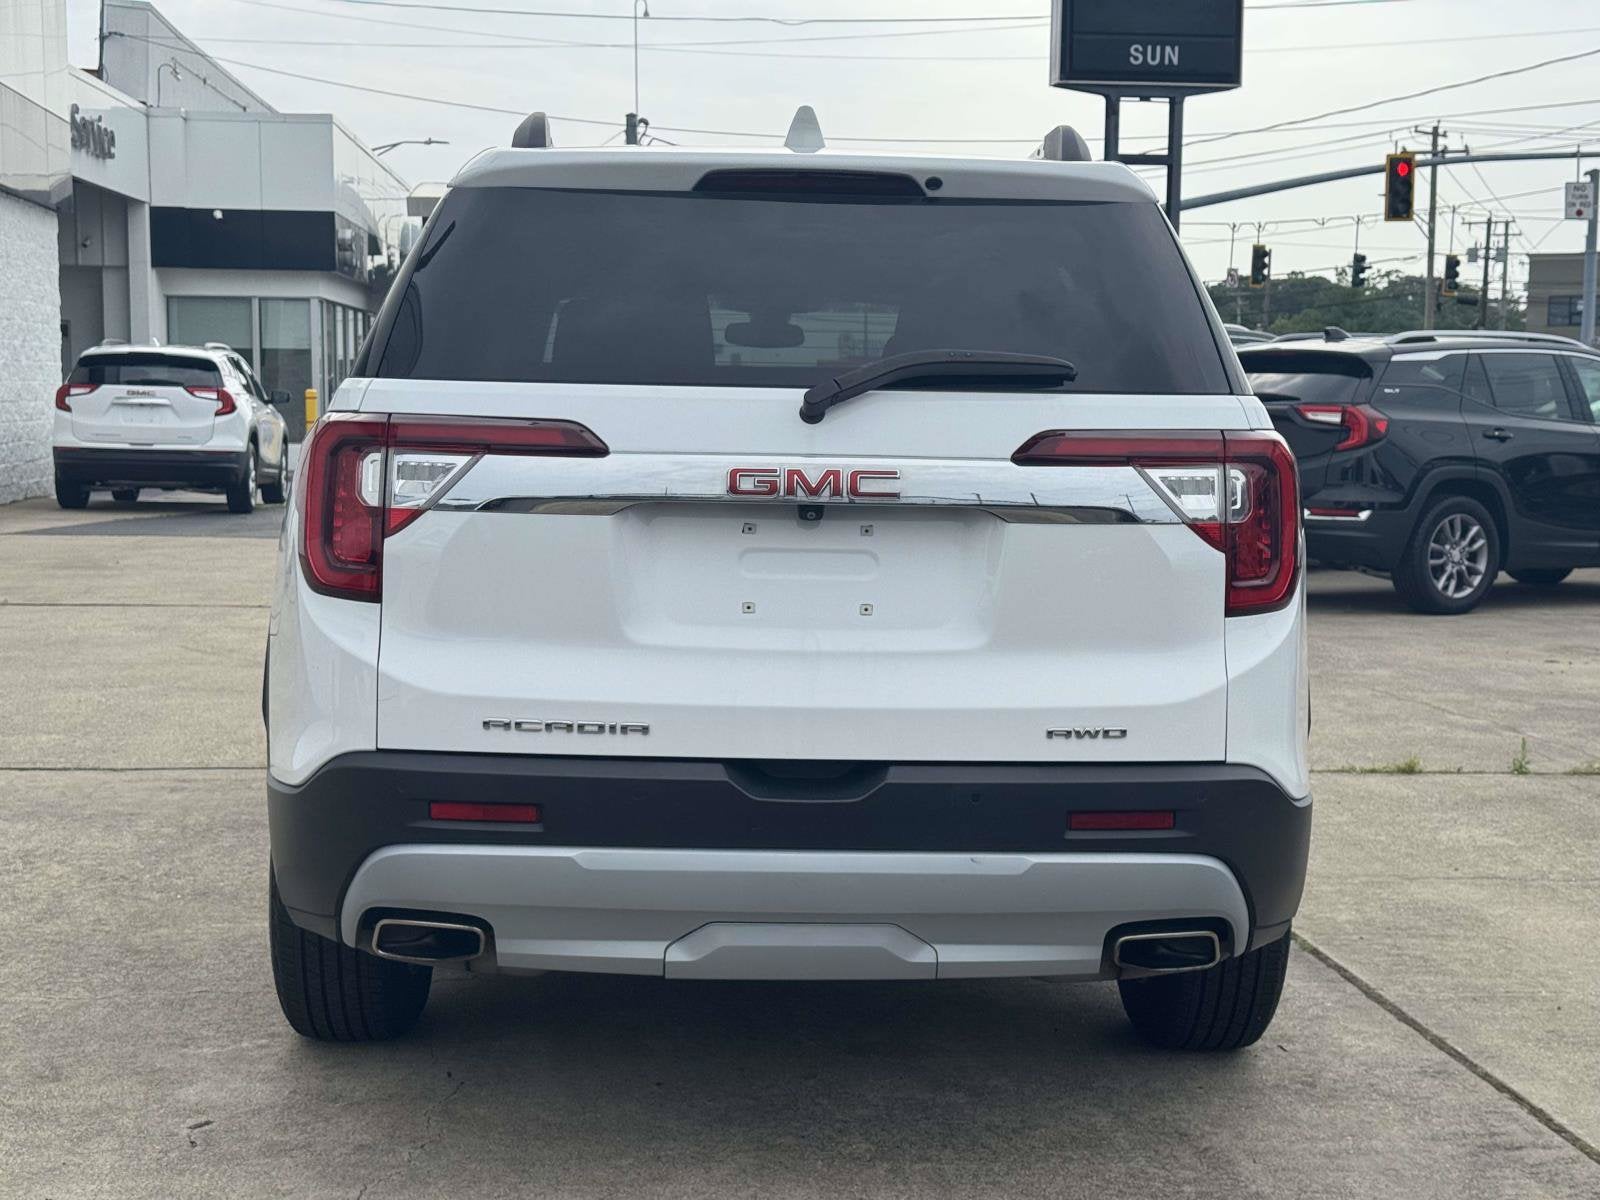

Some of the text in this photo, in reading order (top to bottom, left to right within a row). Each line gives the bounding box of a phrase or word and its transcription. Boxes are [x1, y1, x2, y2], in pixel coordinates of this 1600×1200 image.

[1129, 44, 1179, 66] SUN
[70, 103, 116, 159] Service
[1573, 185, 1587, 193] NO
[727, 467, 901, 499] GMC
[482, 717, 650, 735] ACADIA
[1046, 727, 1128, 740] AWD
